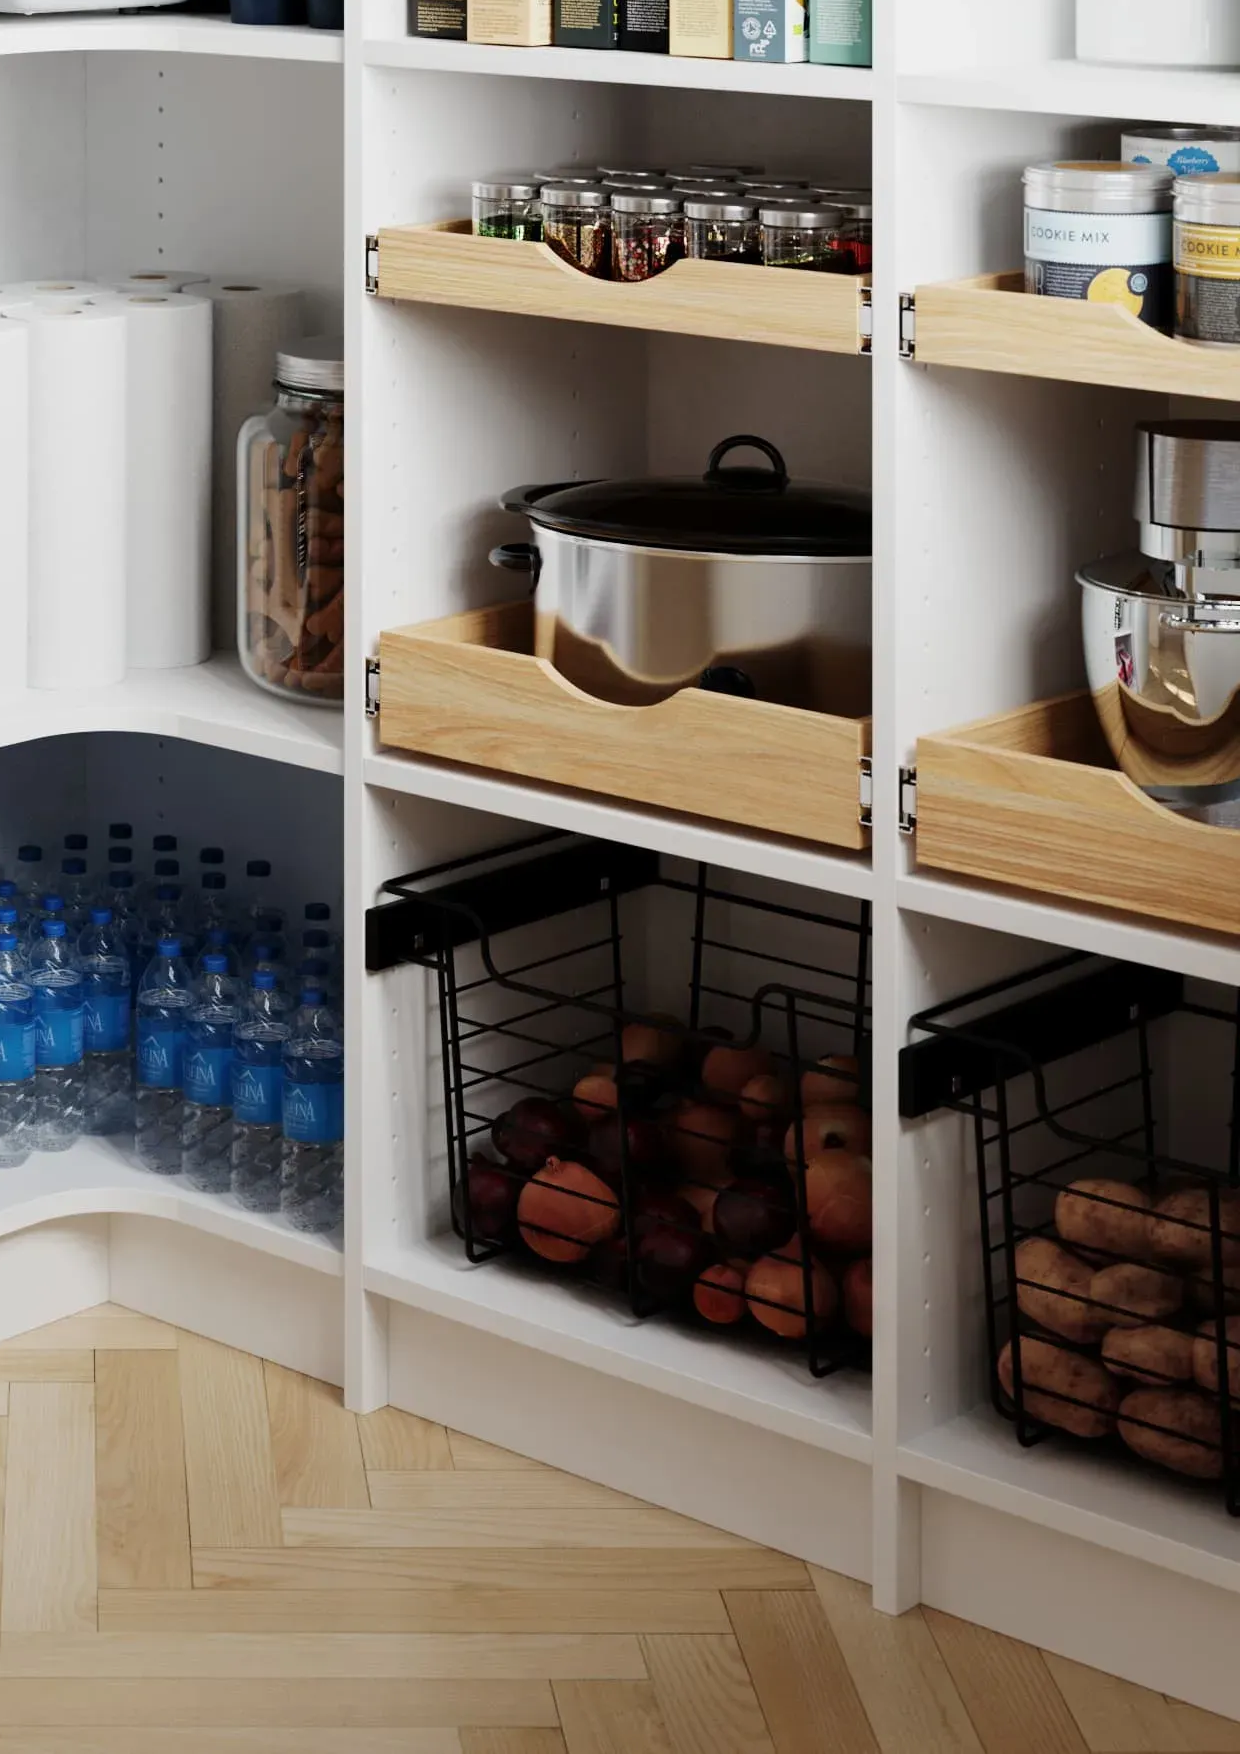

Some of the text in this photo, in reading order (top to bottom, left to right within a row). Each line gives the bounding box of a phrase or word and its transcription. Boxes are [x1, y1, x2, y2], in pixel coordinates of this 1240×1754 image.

[1031, 226, 1110, 244] COOKIE MIX
[1181, 240, 1229, 256] COOKIE
